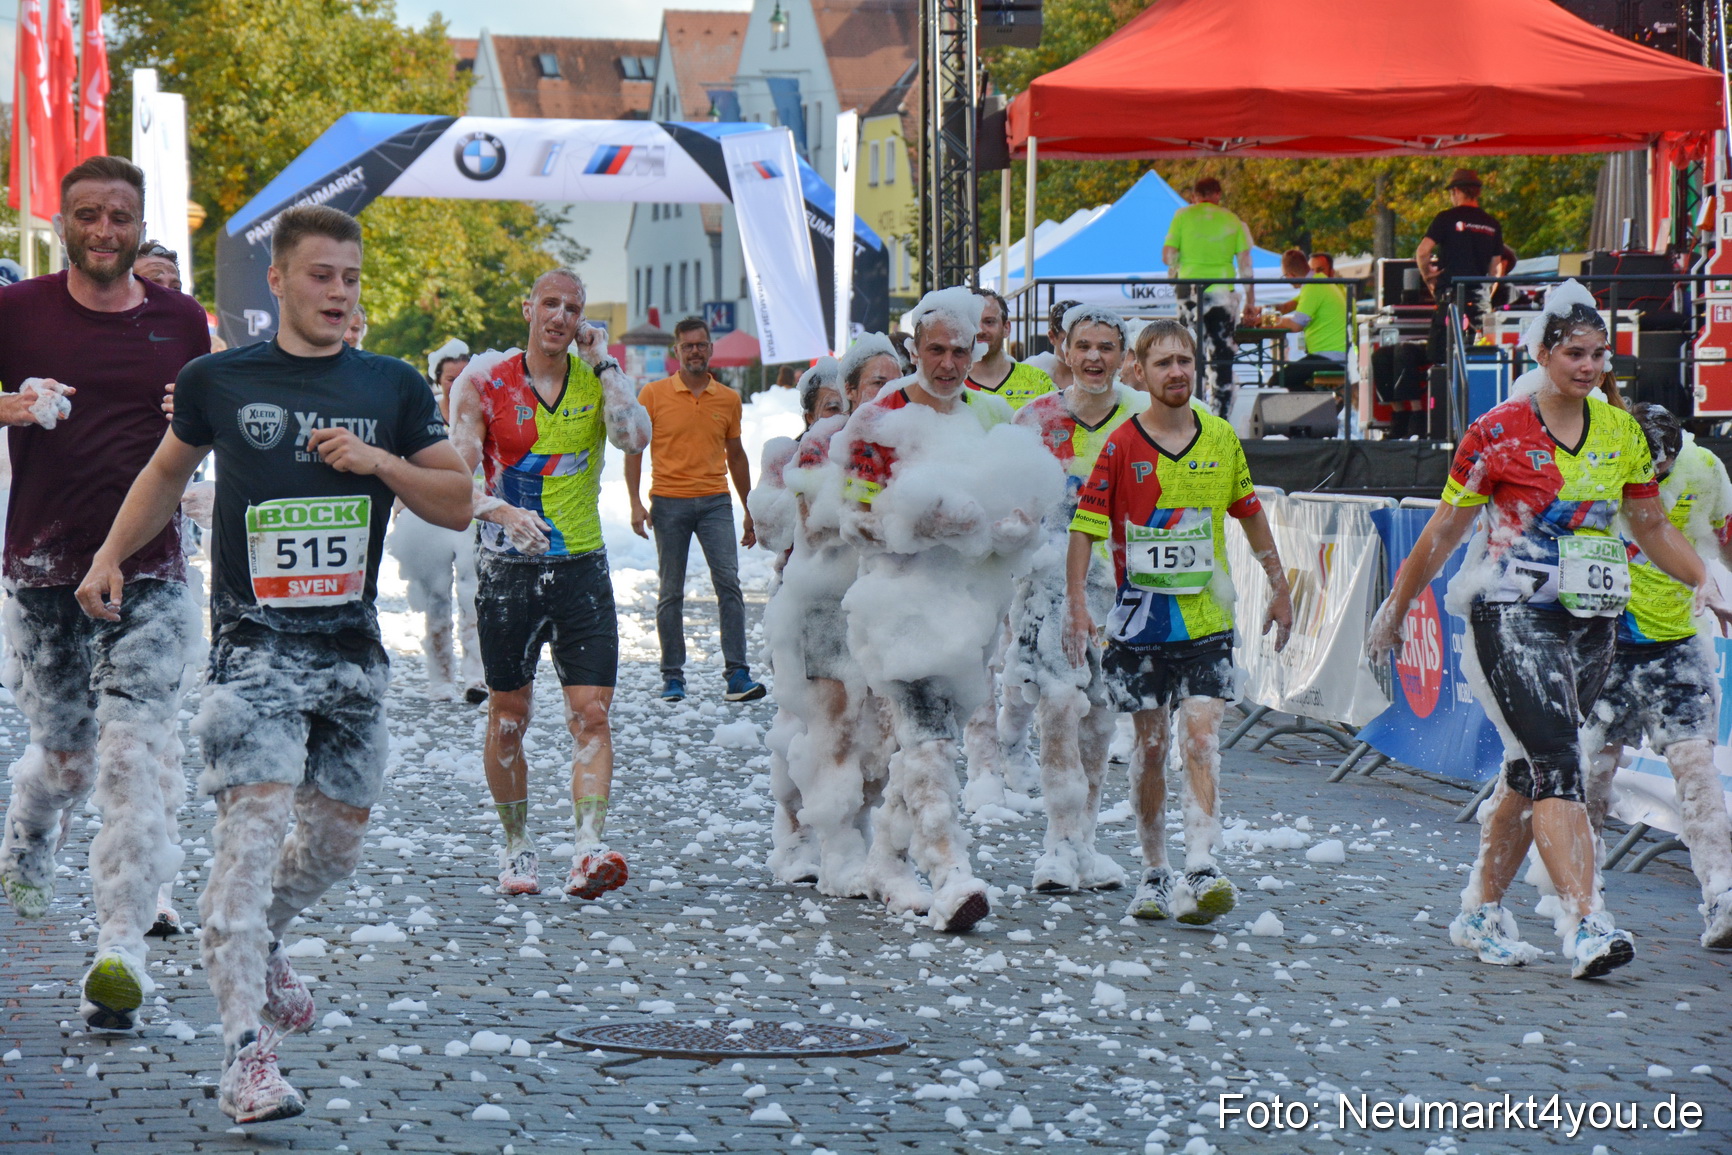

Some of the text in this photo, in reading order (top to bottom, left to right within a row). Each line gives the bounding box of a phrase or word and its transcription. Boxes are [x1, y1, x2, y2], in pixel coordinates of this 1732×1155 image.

[249, 408, 276, 419] XLETIX
[295, 452, 311, 462] Ein
[256, 502, 361, 528] BOCK
[277, 536, 347, 569] 515
[1147, 546, 1196, 568] 159
[288, 579, 338, 594] SVEN
[1588, 564, 1613, 591] 86
[1120, 597, 1142, 637] 7
